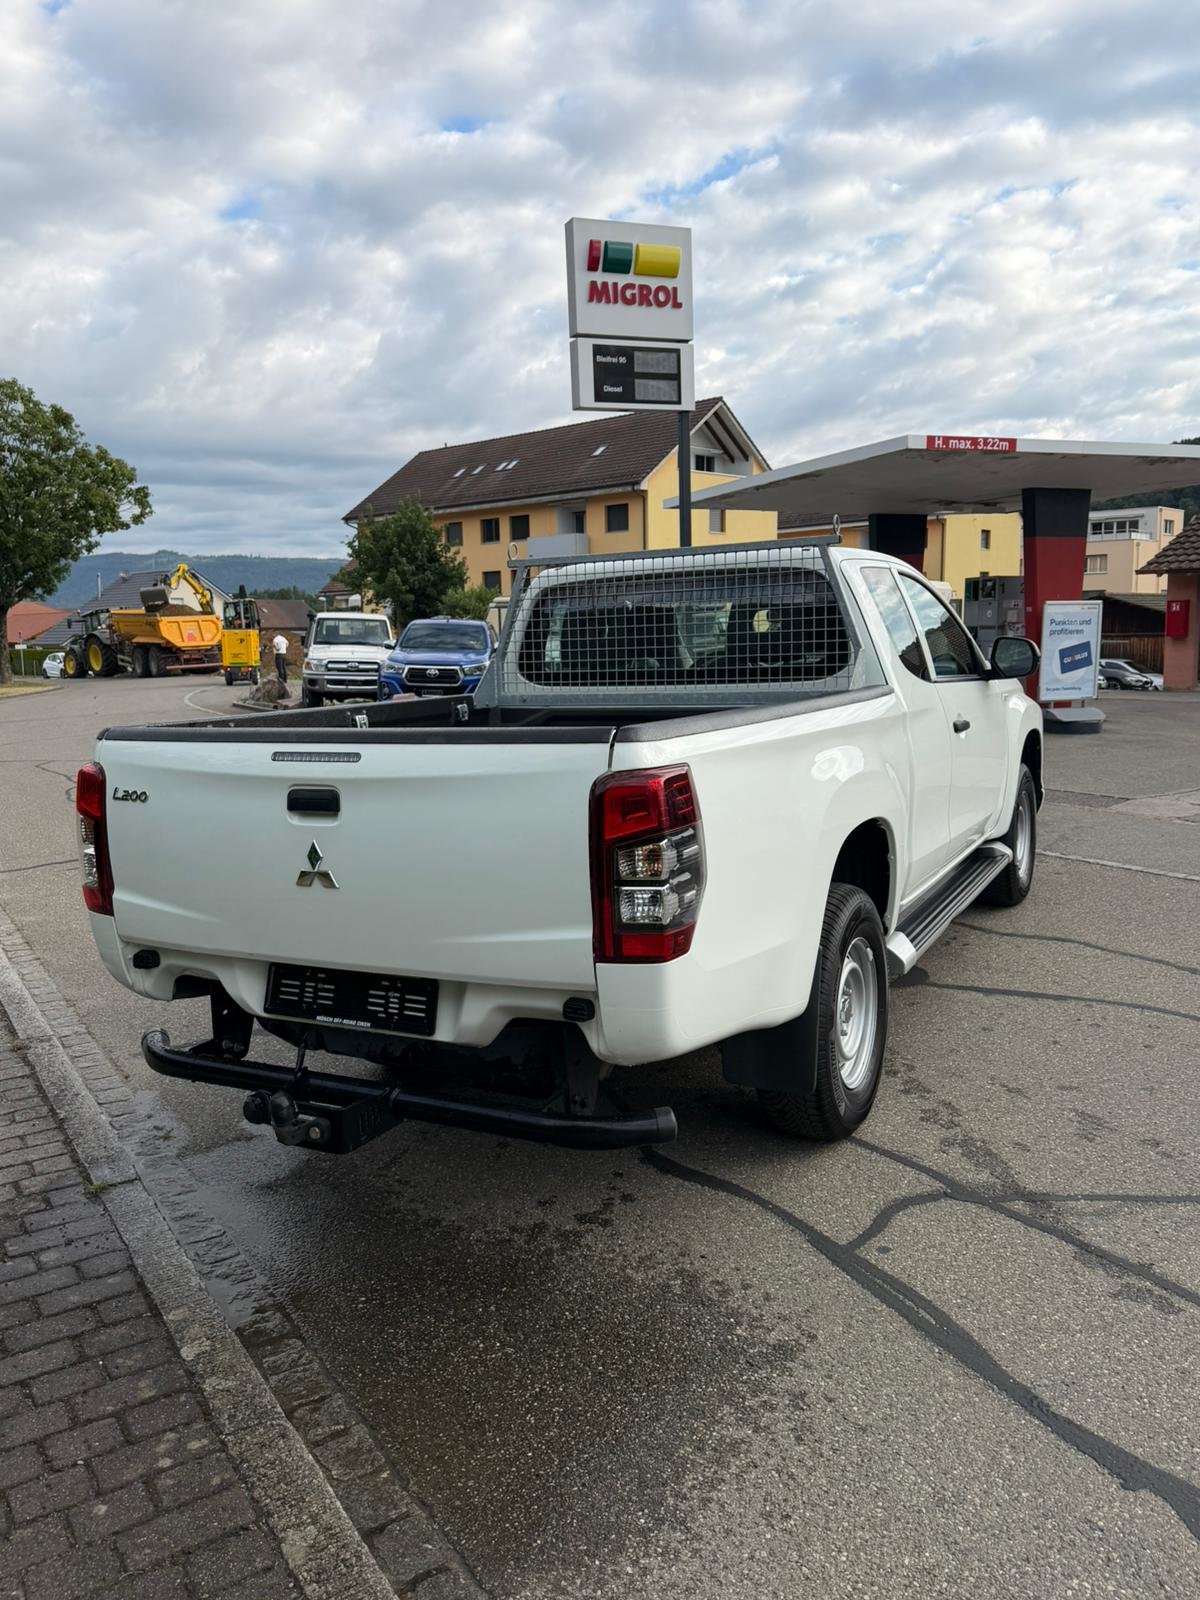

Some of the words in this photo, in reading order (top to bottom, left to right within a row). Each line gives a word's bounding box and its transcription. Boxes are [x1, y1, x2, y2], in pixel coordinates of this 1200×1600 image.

[588, 280, 683, 309] MIGROL
[603, 384, 623, 393] Diesel
[934, 436, 946, 449] H.
[948, 439, 975, 449] max.
[977, 438, 1009, 451] 3.22m
[1049, 618, 1078, 626] Punkten
[1078, 618, 1092, 626] und
[1048, 628, 1085, 637] profitieren
[112, 786, 149, 803] L200
